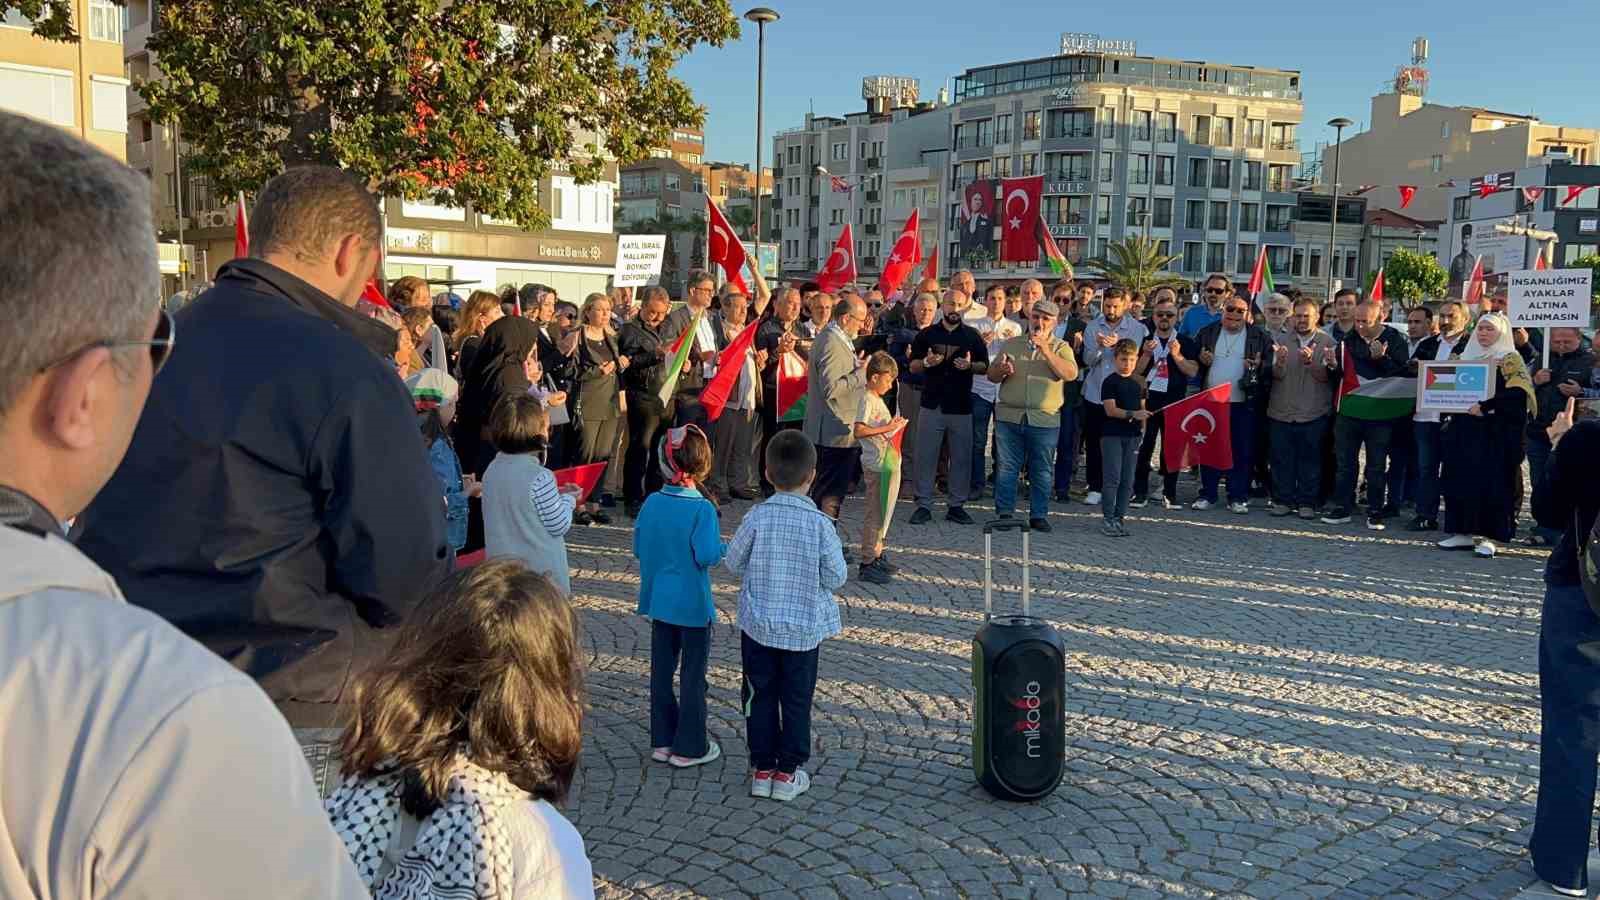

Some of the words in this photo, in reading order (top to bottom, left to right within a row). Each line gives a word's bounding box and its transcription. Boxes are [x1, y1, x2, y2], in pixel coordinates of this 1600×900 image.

[1063, 38, 1096, 49] KULE
[1097, 39, 1135, 50] HOTEL
[1049, 183, 1085, 193] KULE
[1050, 225, 1085, 235] OTEL
[539, 246, 591, 257] DenizBank
[1523, 289, 1575, 298] AYAKLAR
[1528, 301, 1568, 309] ALTINA
[1517, 313, 1579, 321] ALINMASIN
[1023, 680, 1041, 758] mikado
